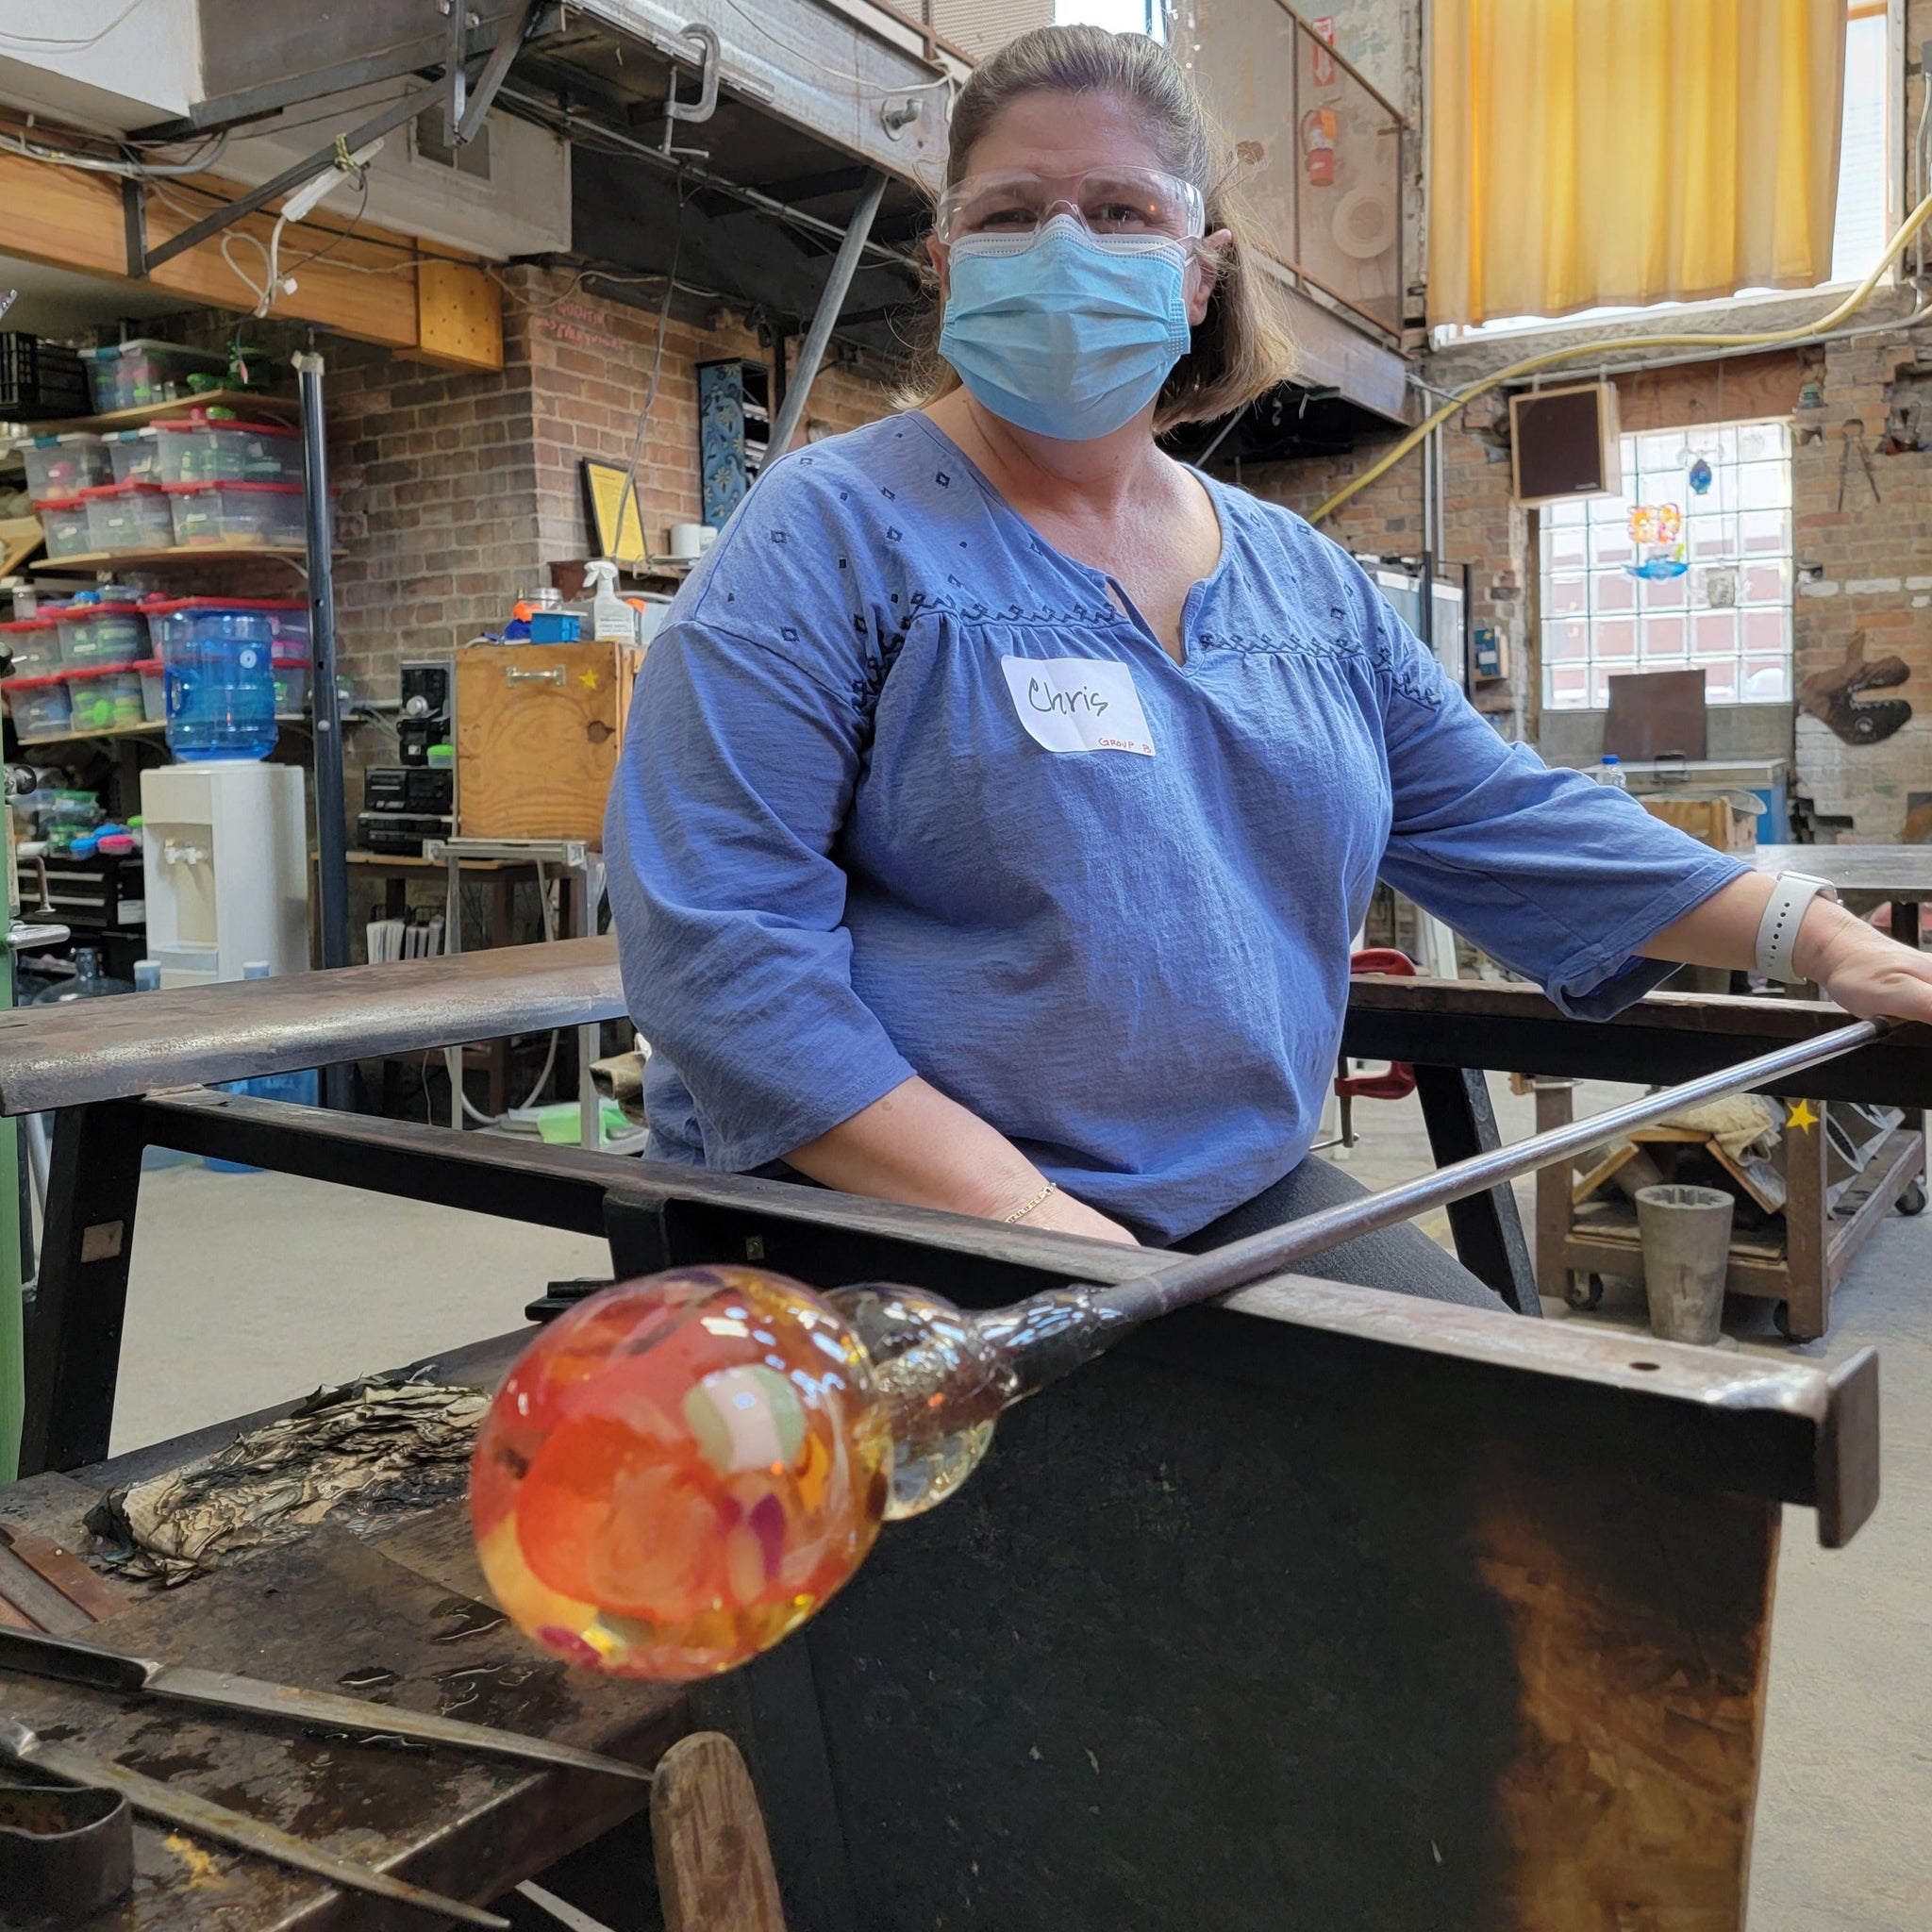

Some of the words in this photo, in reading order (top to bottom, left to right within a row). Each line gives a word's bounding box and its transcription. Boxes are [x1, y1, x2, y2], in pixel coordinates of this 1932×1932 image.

[1028, 677, 1108, 717] Chris
[1097, 737, 1135, 750] GROUP
[1141, 743, 1153, 754] B
